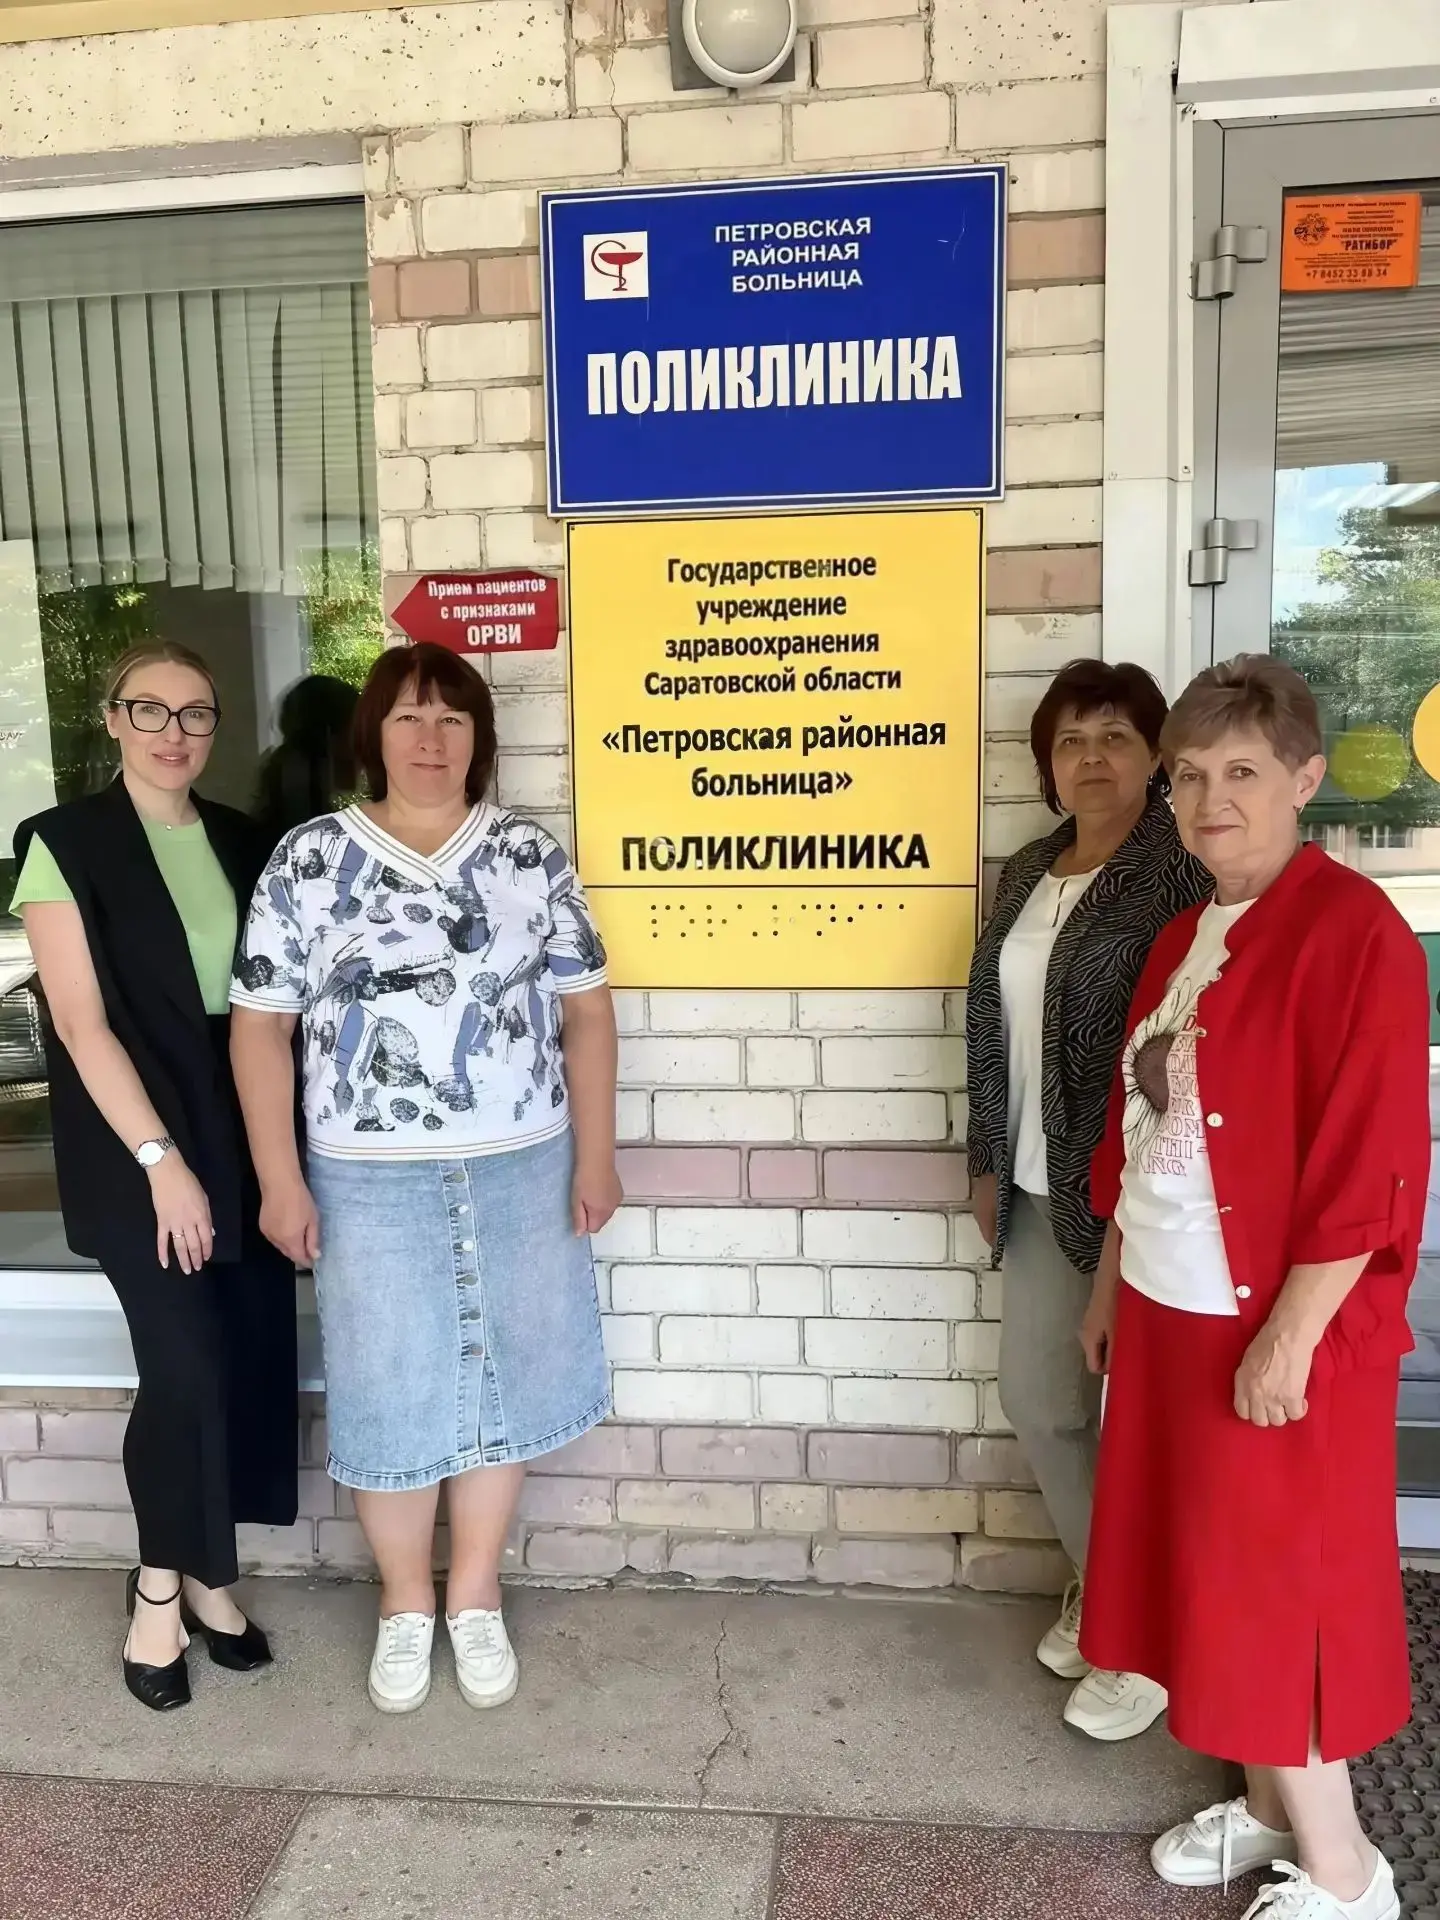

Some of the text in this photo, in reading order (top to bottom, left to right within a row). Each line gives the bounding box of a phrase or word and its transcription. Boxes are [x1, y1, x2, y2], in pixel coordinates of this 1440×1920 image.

[715, 217, 872, 244] ПЕТРОВСКАЯ
[731, 241, 860, 267] РАЙОННАЯ
[732, 269, 863, 293] БОЛЬНИЦА
[587, 335, 962, 415] ПОЛИКЛИНИКА
[667, 557, 877, 585] Государственное
[428, 578, 547, 600] Прием пациентов
[441, 602, 535, 621] с признаками
[697, 595, 847, 625] учреждение
[467, 623, 522, 646] ОРВИ
[665, 631, 879, 662] здравоохранения
[644, 666, 902, 700] Саратовской области
[602, 715, 946, 759] «Петровская районная
[691, 766, 853, 799] больница»
[622, 834, 931, 872] ПОЛИКЛИНИКА
